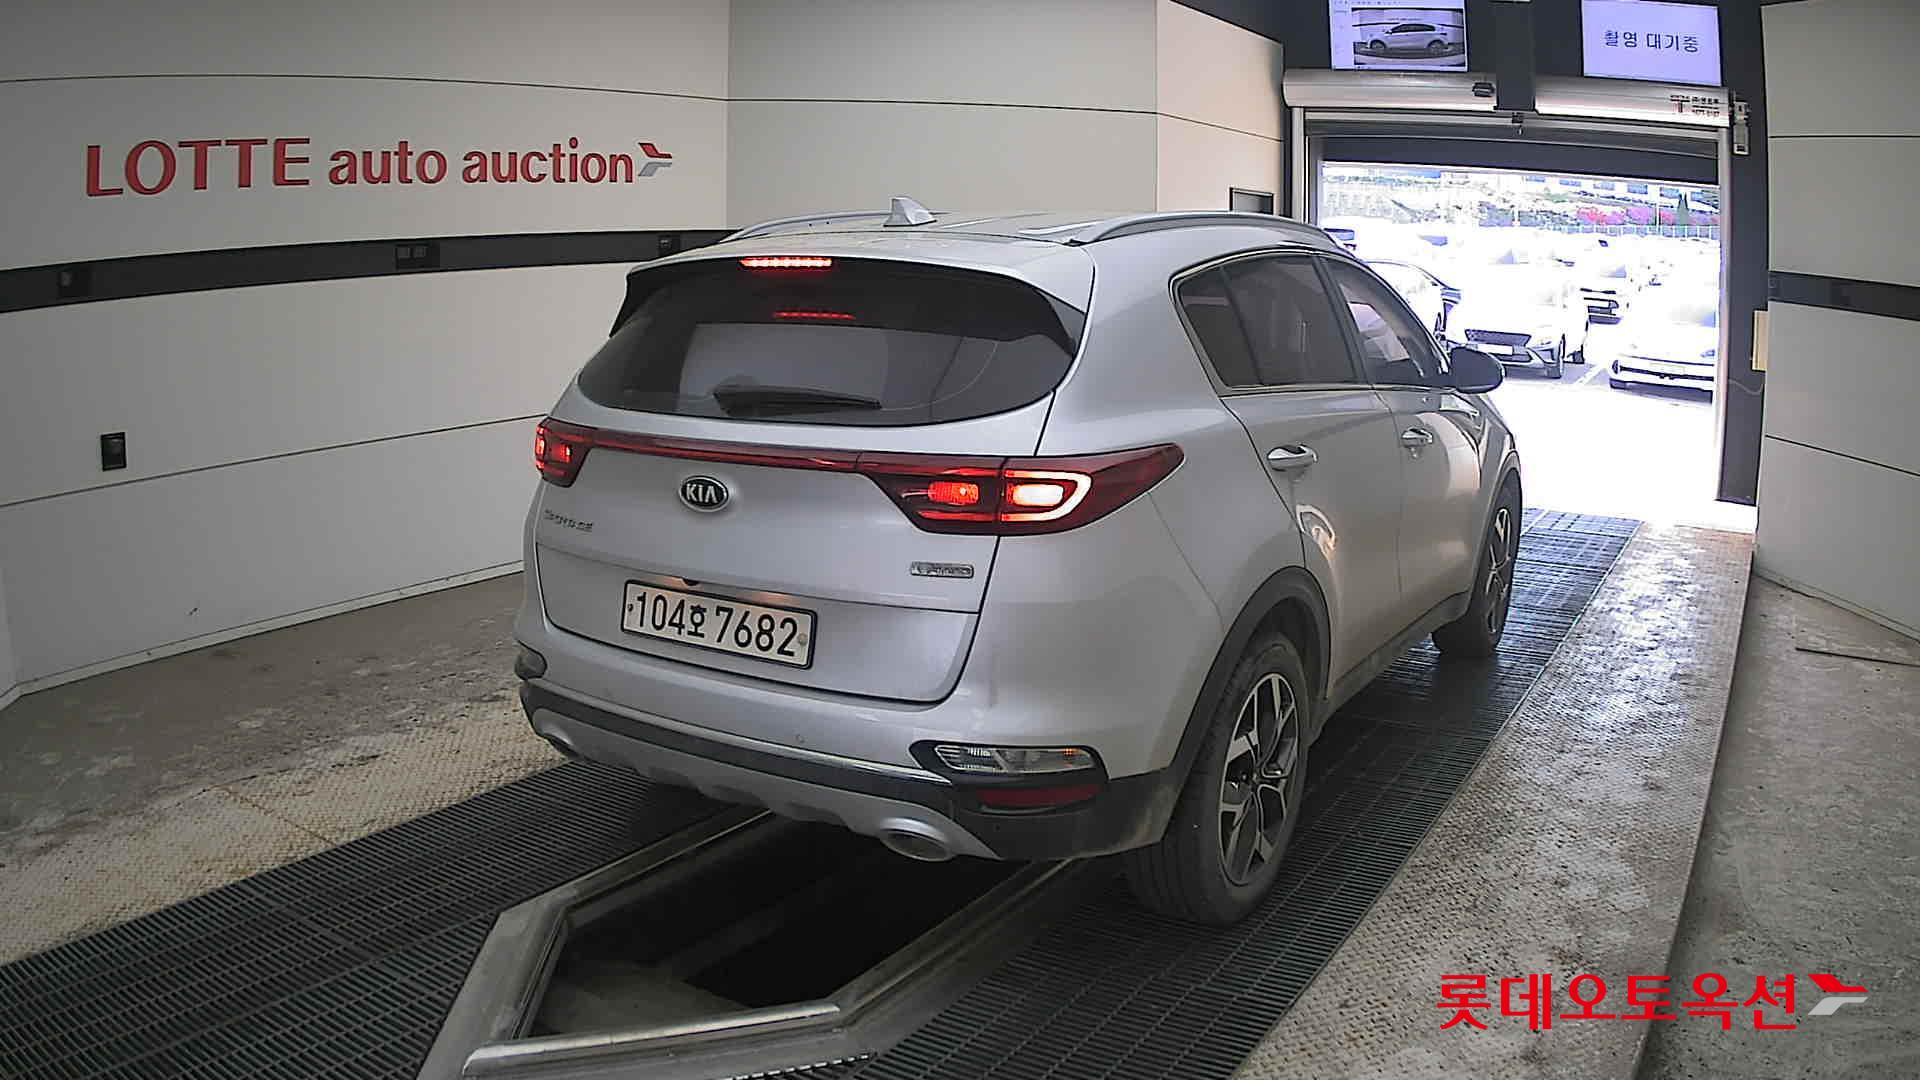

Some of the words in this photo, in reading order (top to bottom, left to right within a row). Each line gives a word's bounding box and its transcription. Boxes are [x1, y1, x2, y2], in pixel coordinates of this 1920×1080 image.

[1603, 30, 1638, 48] 촬영
[1646, 33, 1699, 53] 대기중
[86, 137, 311, 197] LOTTE
[328, 140, 448, 186] auto
[461, 137, 637, 185] auction
[685, 482, 720, 504] KIA
[637, 591, 708, 640] 104호
[715, 605, 798, 658] 7682
